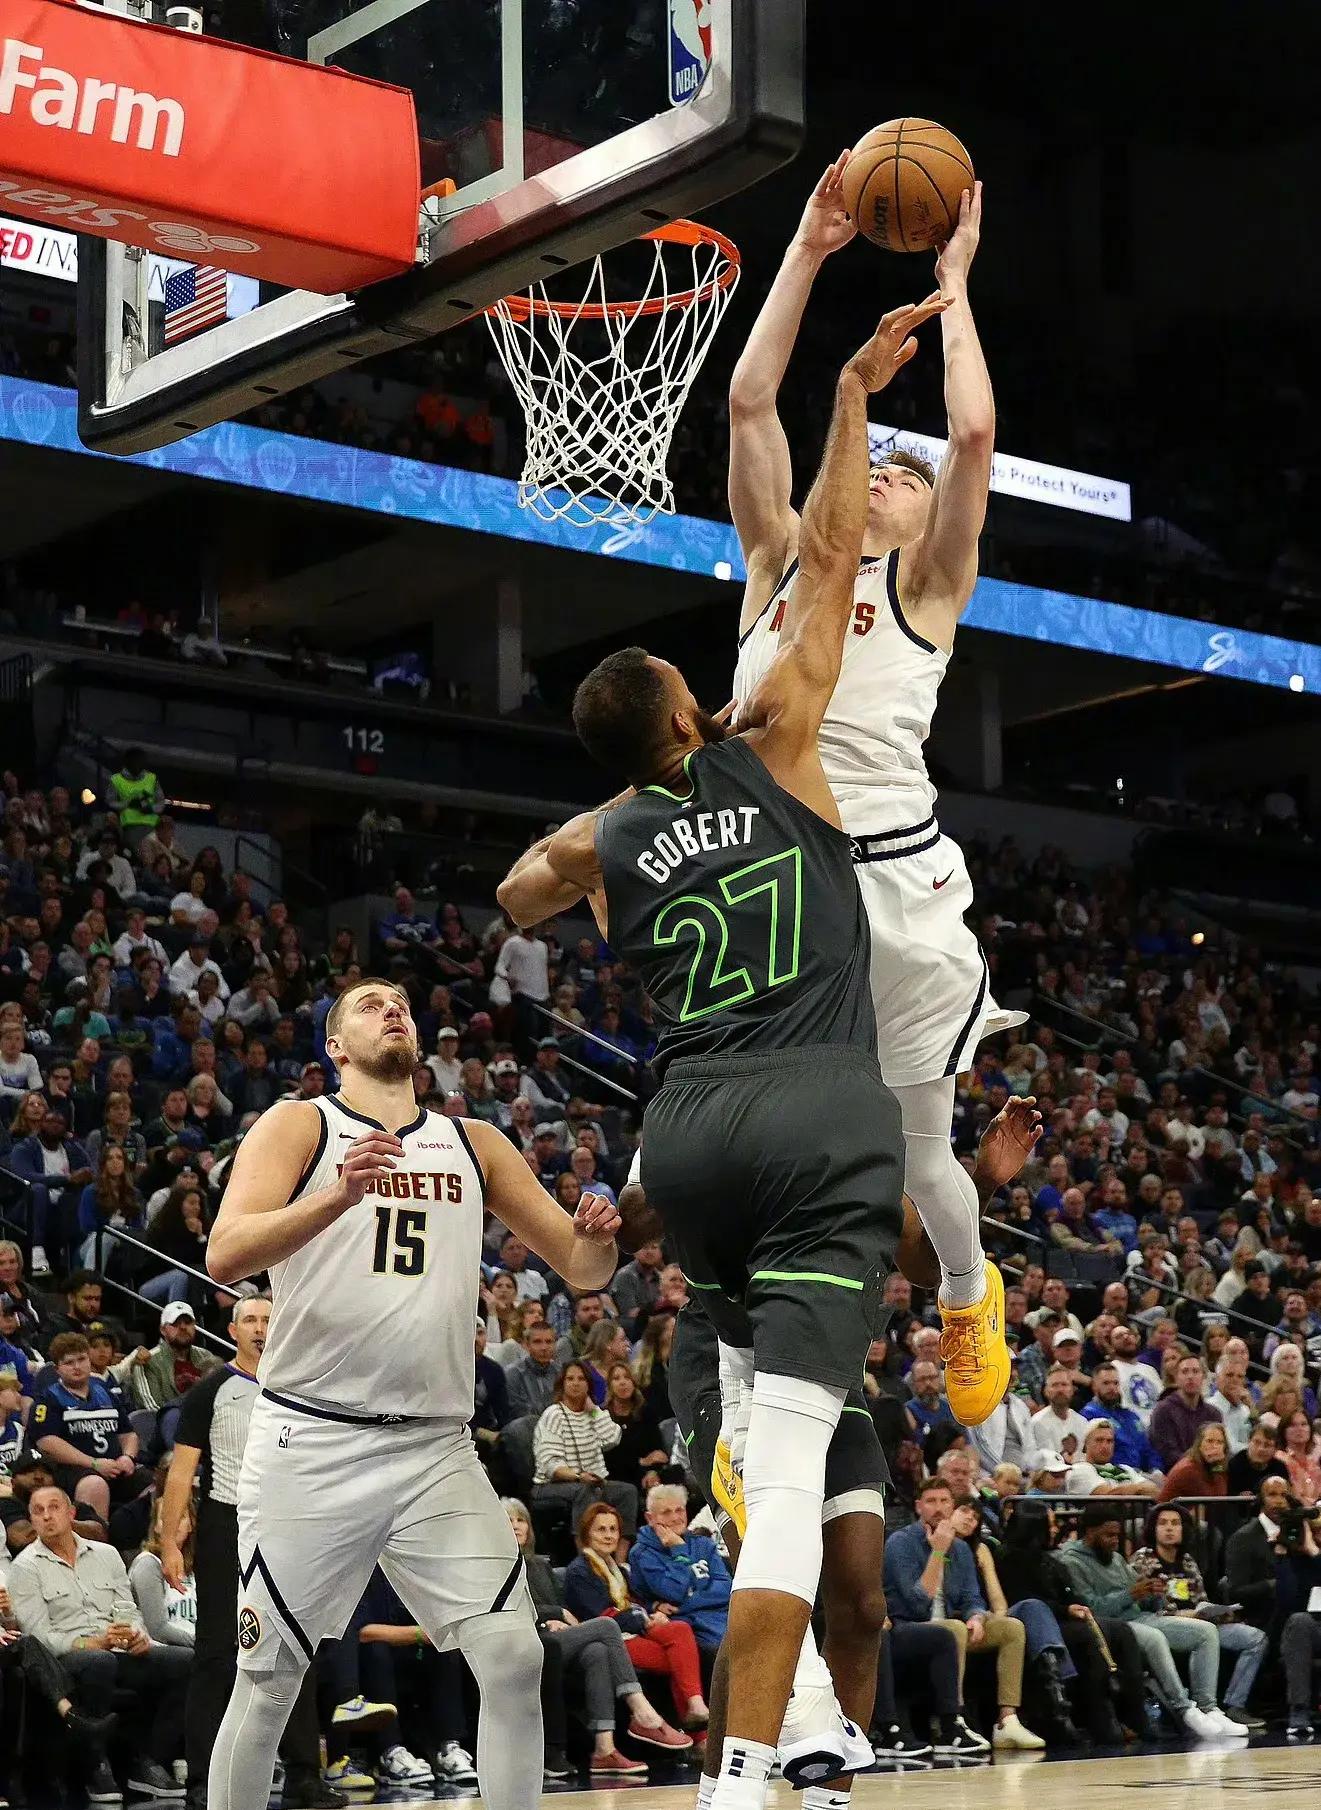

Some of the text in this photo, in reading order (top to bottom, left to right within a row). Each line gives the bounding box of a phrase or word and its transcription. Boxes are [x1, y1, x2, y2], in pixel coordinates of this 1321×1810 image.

[675, 64, 699, 96] NBA
[0, 38, 186, 158] Farm
[1011, 467, 1064, 493] Protect
[343, 726, 385, 753] 112
[637, 806, 760, 884] GOBERT
[653, 845, 802, 1023] 27
[417, 1141, 454, 1151] ibotta
[336, 1163, 463, 1204] GGETS
[371, 1205, 428, 1278] 15
[35, 1404, 47, 1423] 9
[93, 1430, 109, 1454] 5
